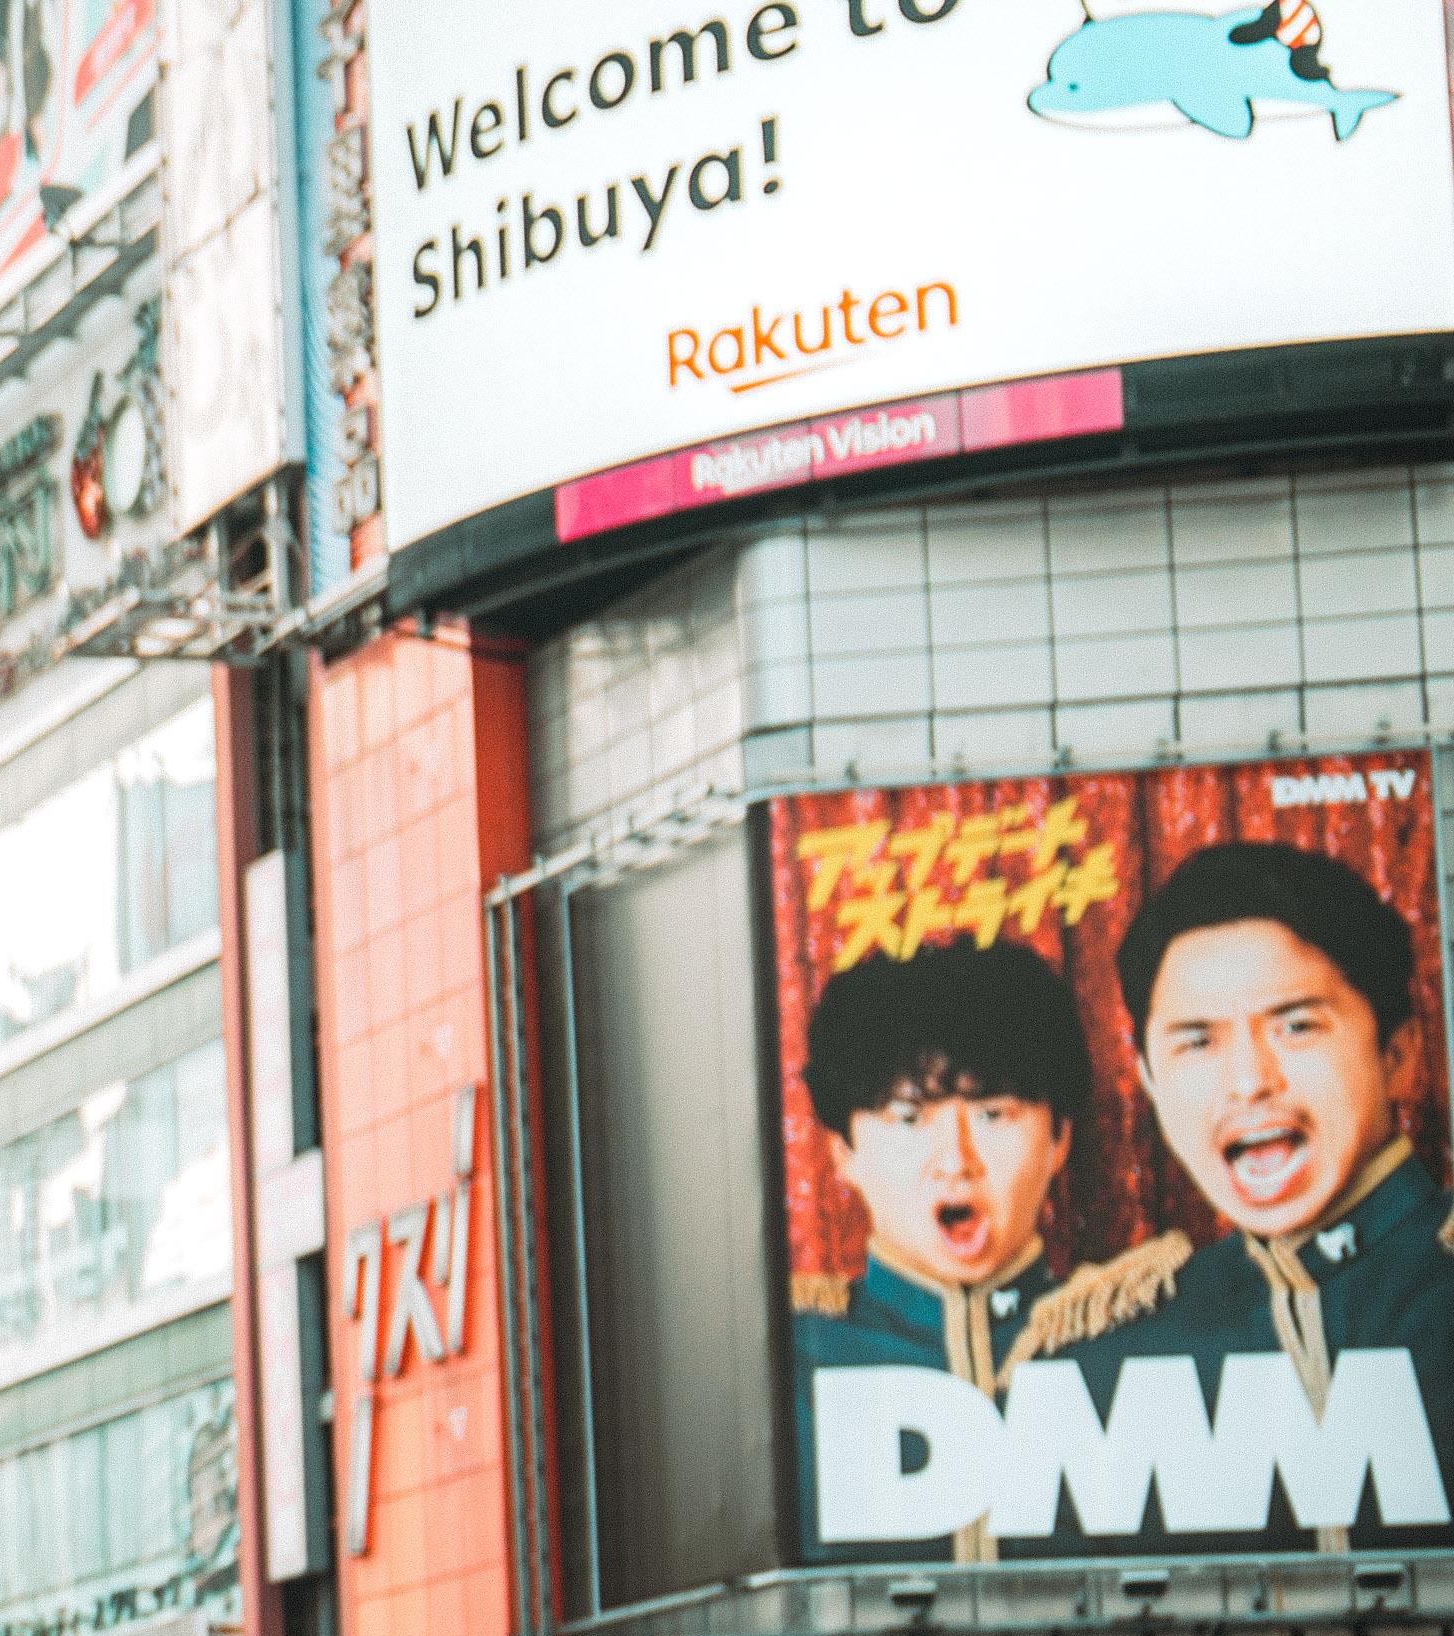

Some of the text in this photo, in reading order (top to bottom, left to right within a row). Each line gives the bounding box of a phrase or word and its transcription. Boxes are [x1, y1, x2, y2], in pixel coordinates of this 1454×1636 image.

[406, 0, 799, 190] Welcome
[411, 116, 785, 320] Shibuya!
[666, 279, 960, 393] Rakuten
[693, 410, 936, 494] Rakuten Vision
[1273, 769, 1416, 807] DMM TV
[796, 798, 1084, 912] アップデート
[832, 842, 1120, 974] ストライキ
[813, 1346, 1450, 1542] DMM
